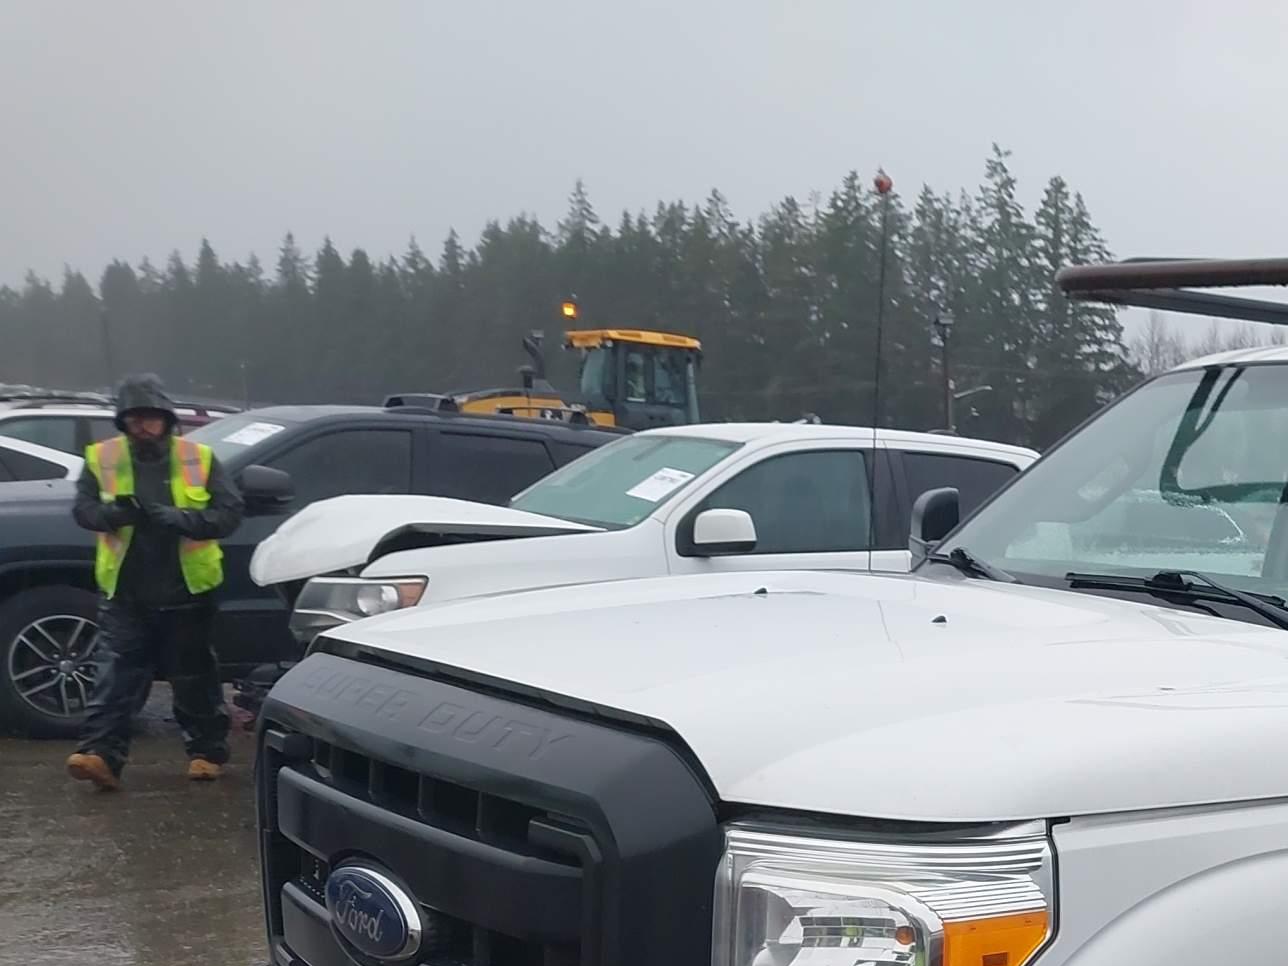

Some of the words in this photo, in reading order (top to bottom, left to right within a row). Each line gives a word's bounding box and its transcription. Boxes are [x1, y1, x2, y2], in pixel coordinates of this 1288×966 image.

[300, 668, 414, 718] SUPER
[418, 702, 576, 759] DUTY
[335, 879, 385, 942] Ford
